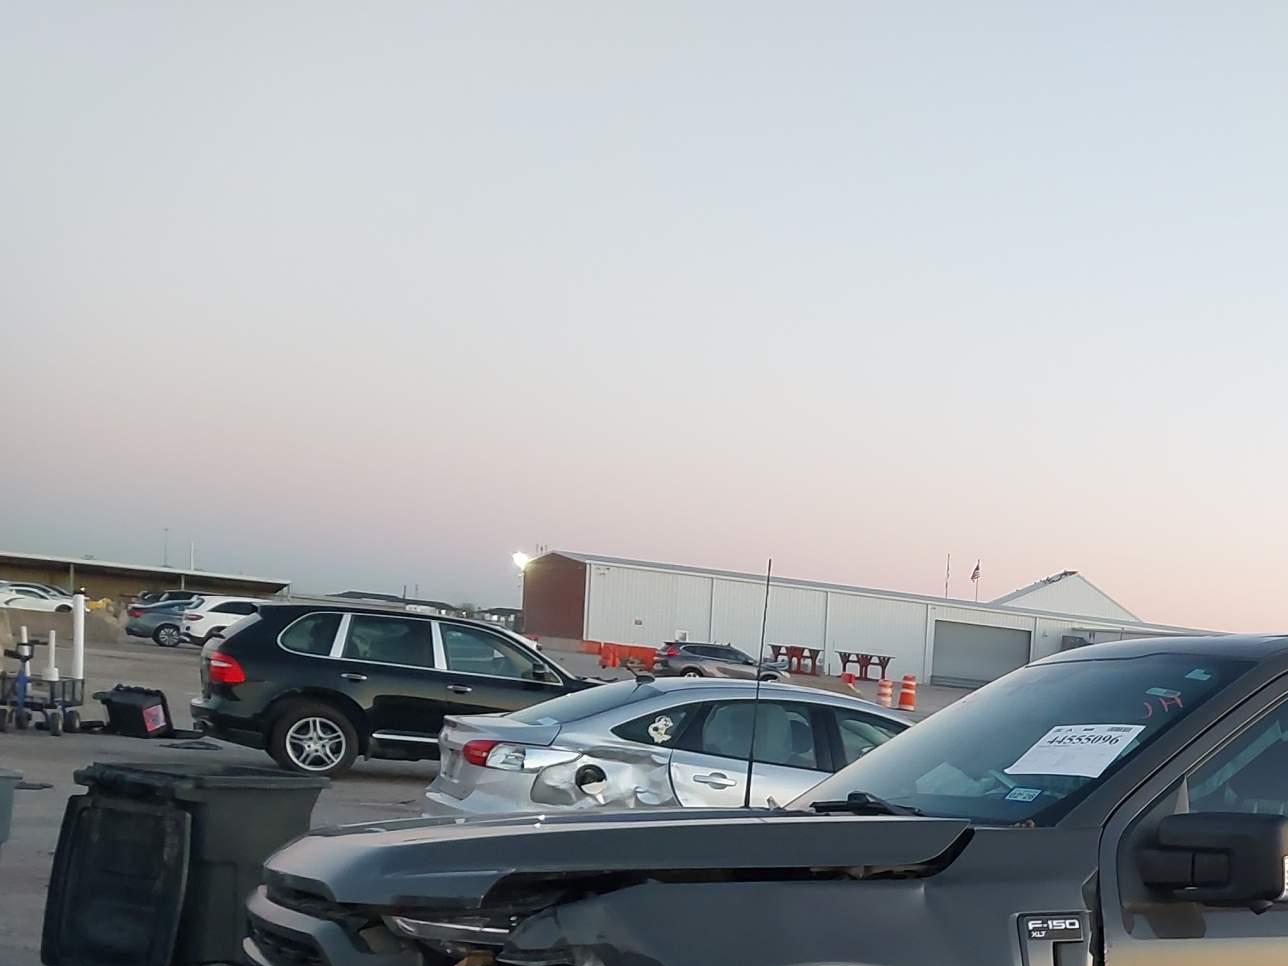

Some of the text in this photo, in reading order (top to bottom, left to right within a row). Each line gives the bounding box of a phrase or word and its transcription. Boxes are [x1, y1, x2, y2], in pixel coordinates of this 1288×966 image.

[1046, 733, 1122, 746] 44555096
[1027, 918, 1081, 931] F-150
[1030, 930, 1048, 939] XLT
